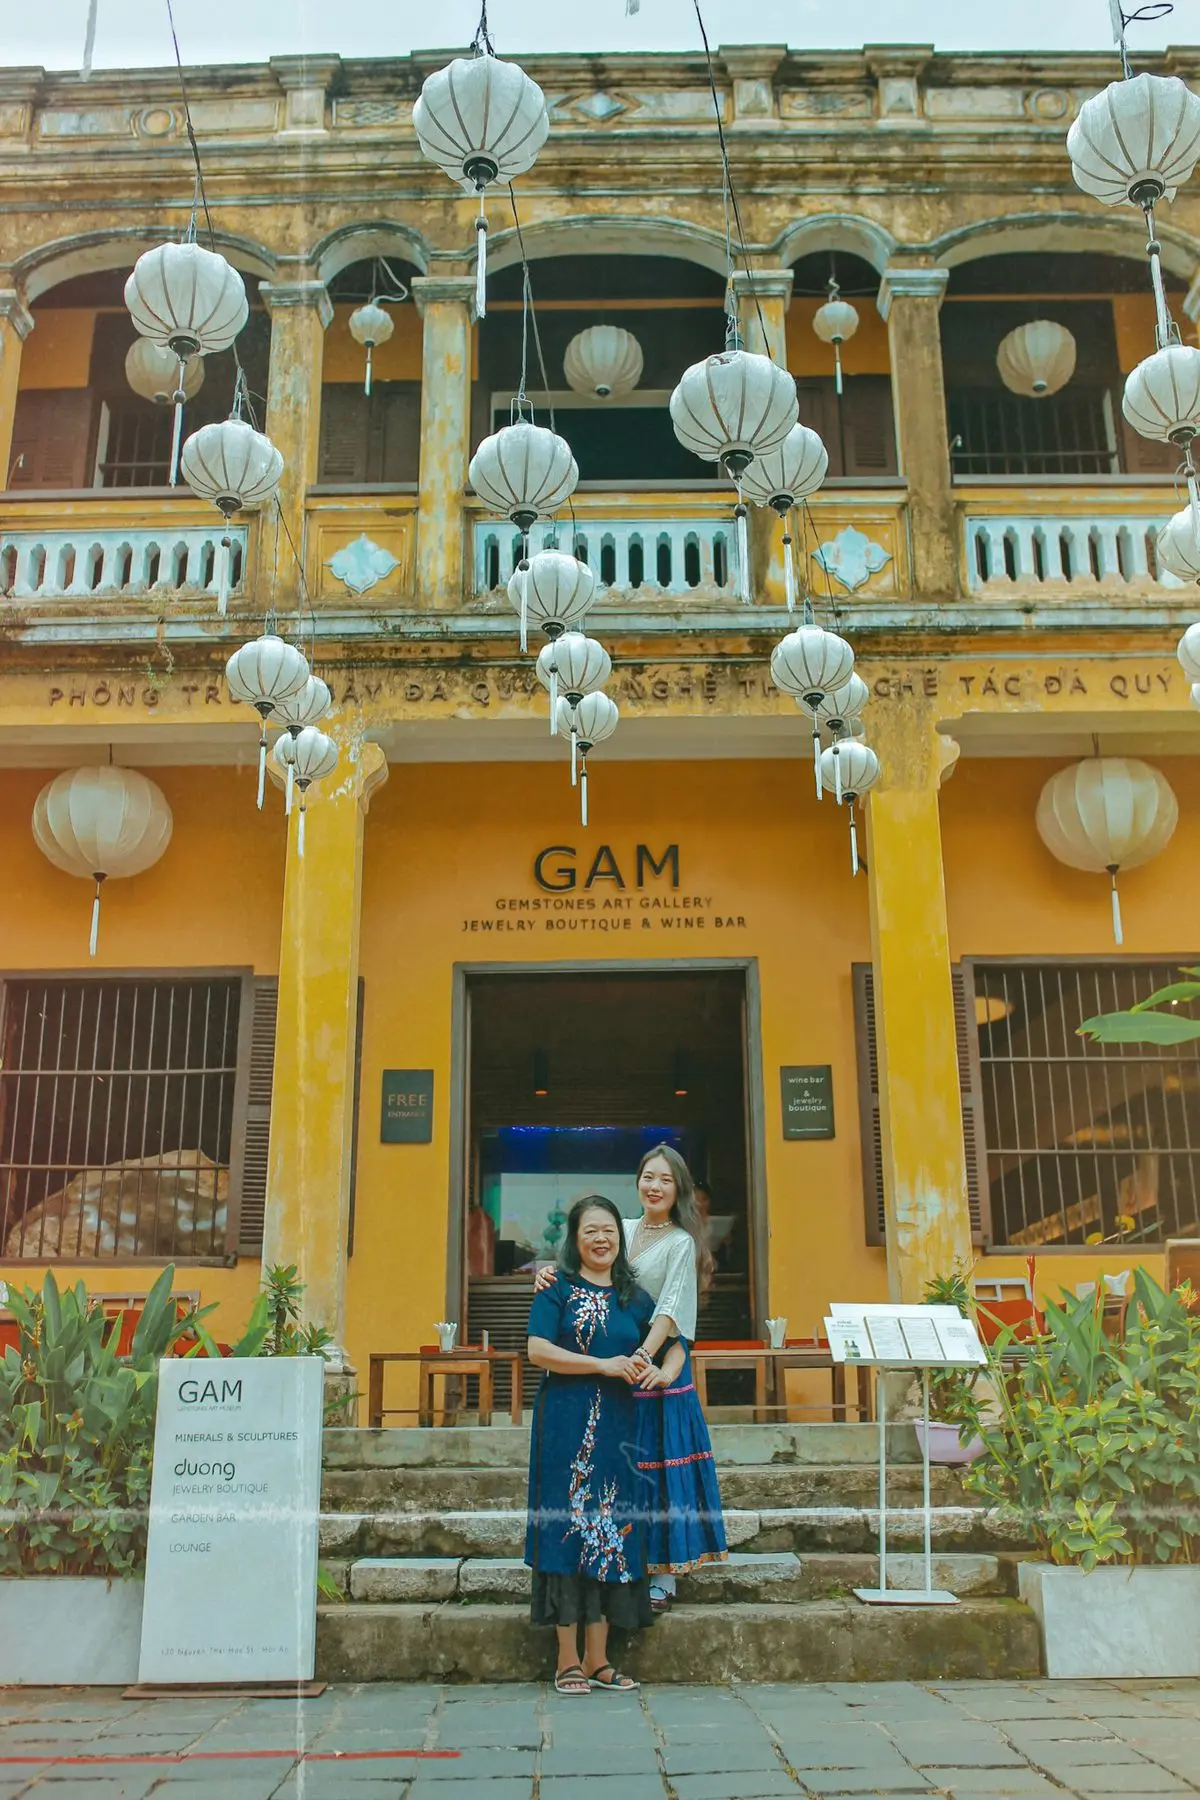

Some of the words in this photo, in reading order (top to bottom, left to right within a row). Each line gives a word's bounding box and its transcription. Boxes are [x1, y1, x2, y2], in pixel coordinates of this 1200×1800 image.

[958, 667, 1021, 697] TÁC
[1043, 668, 1088, 695] ĐÁ
[1109, 667, 1172, 699] QUÝ
[534, 844, 680, 892] GAM
[495, 898, 596, 911] GEMSTONES
[602, 897, 633, 910] ART
[639, 897, 712, 909] GALLERY
[461, 919, 536, 932] JEWELRY
[545, 918, 632, 931] BOUTIQUE
[641, 918, 651, 929] &
[660, 917, 705, 929] WINE
[714, 916, 747, 928] BAR
[809, 1076, 825, 1084] bar
[388, 1093, 428, 1107] FREE
[793, 1097, 823, 1106] jewelry
[788, 1104, 827, 1113] boutique
[178, 1379, 243, 1403] GAM
[175, 1432, 224, 1442] MINERALS
[227, 1432, 234, 1441] &
[237, 1431, 299, 1441] SCULPTURES
[174, 1458, 236, 1481] duong
[172, 1484, 214, 1496] JEWELRY
[216, 1482, 269, 1494] BOUTIQUE
[171, 1513, 214, 1524] GARDEN
[216, 1512, 237, 1523] BAR
[169, 1542, 212, 1553] LOUNGE
